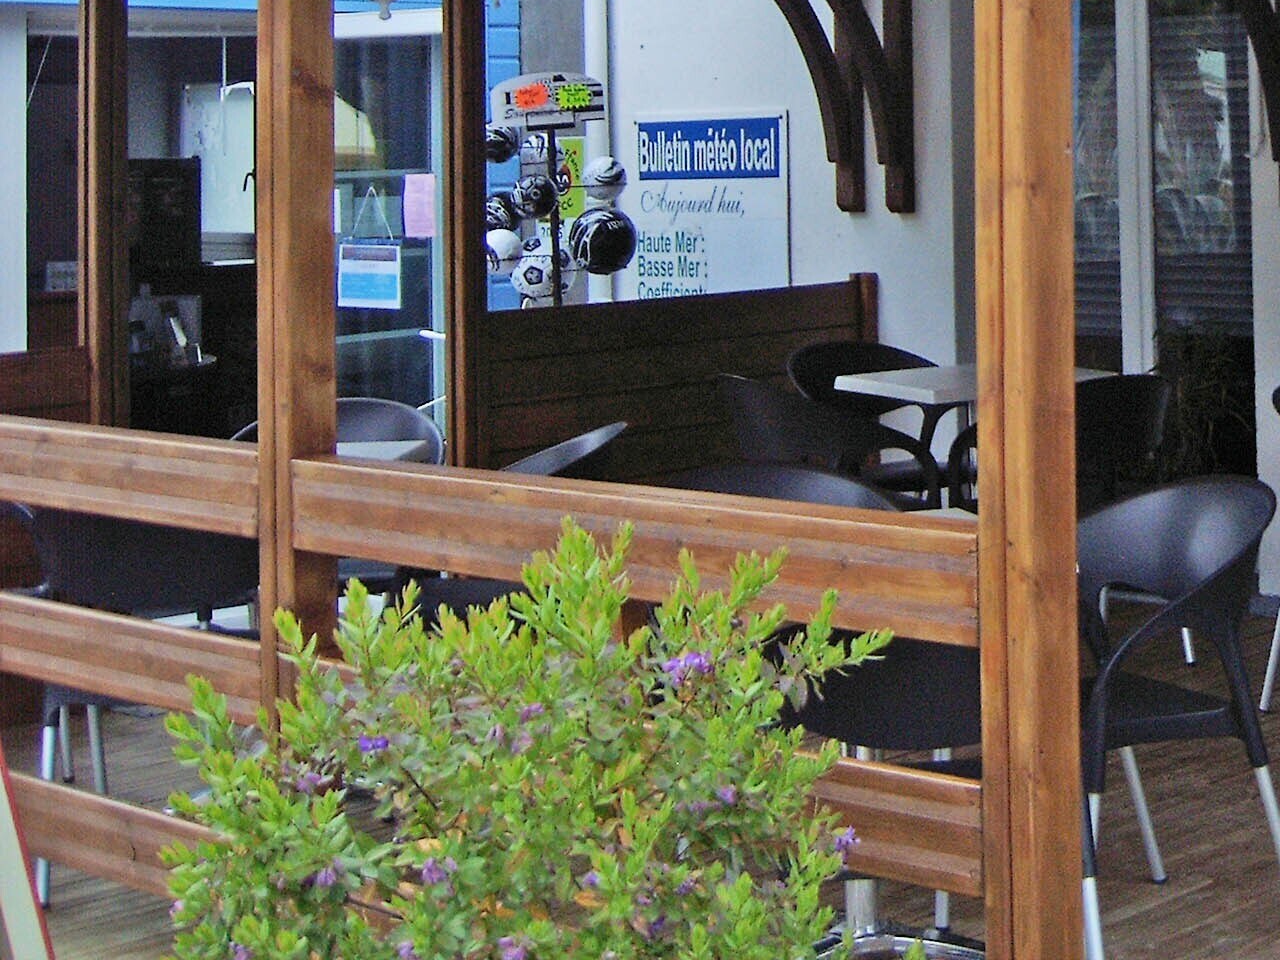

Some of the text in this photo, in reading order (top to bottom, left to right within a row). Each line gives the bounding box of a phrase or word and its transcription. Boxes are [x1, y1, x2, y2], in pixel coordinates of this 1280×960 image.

[638, 127, 776, 173] Bulletin météo local
[637, 231, 671, 253] Haute
[638, 255, 674, 278] Basse
